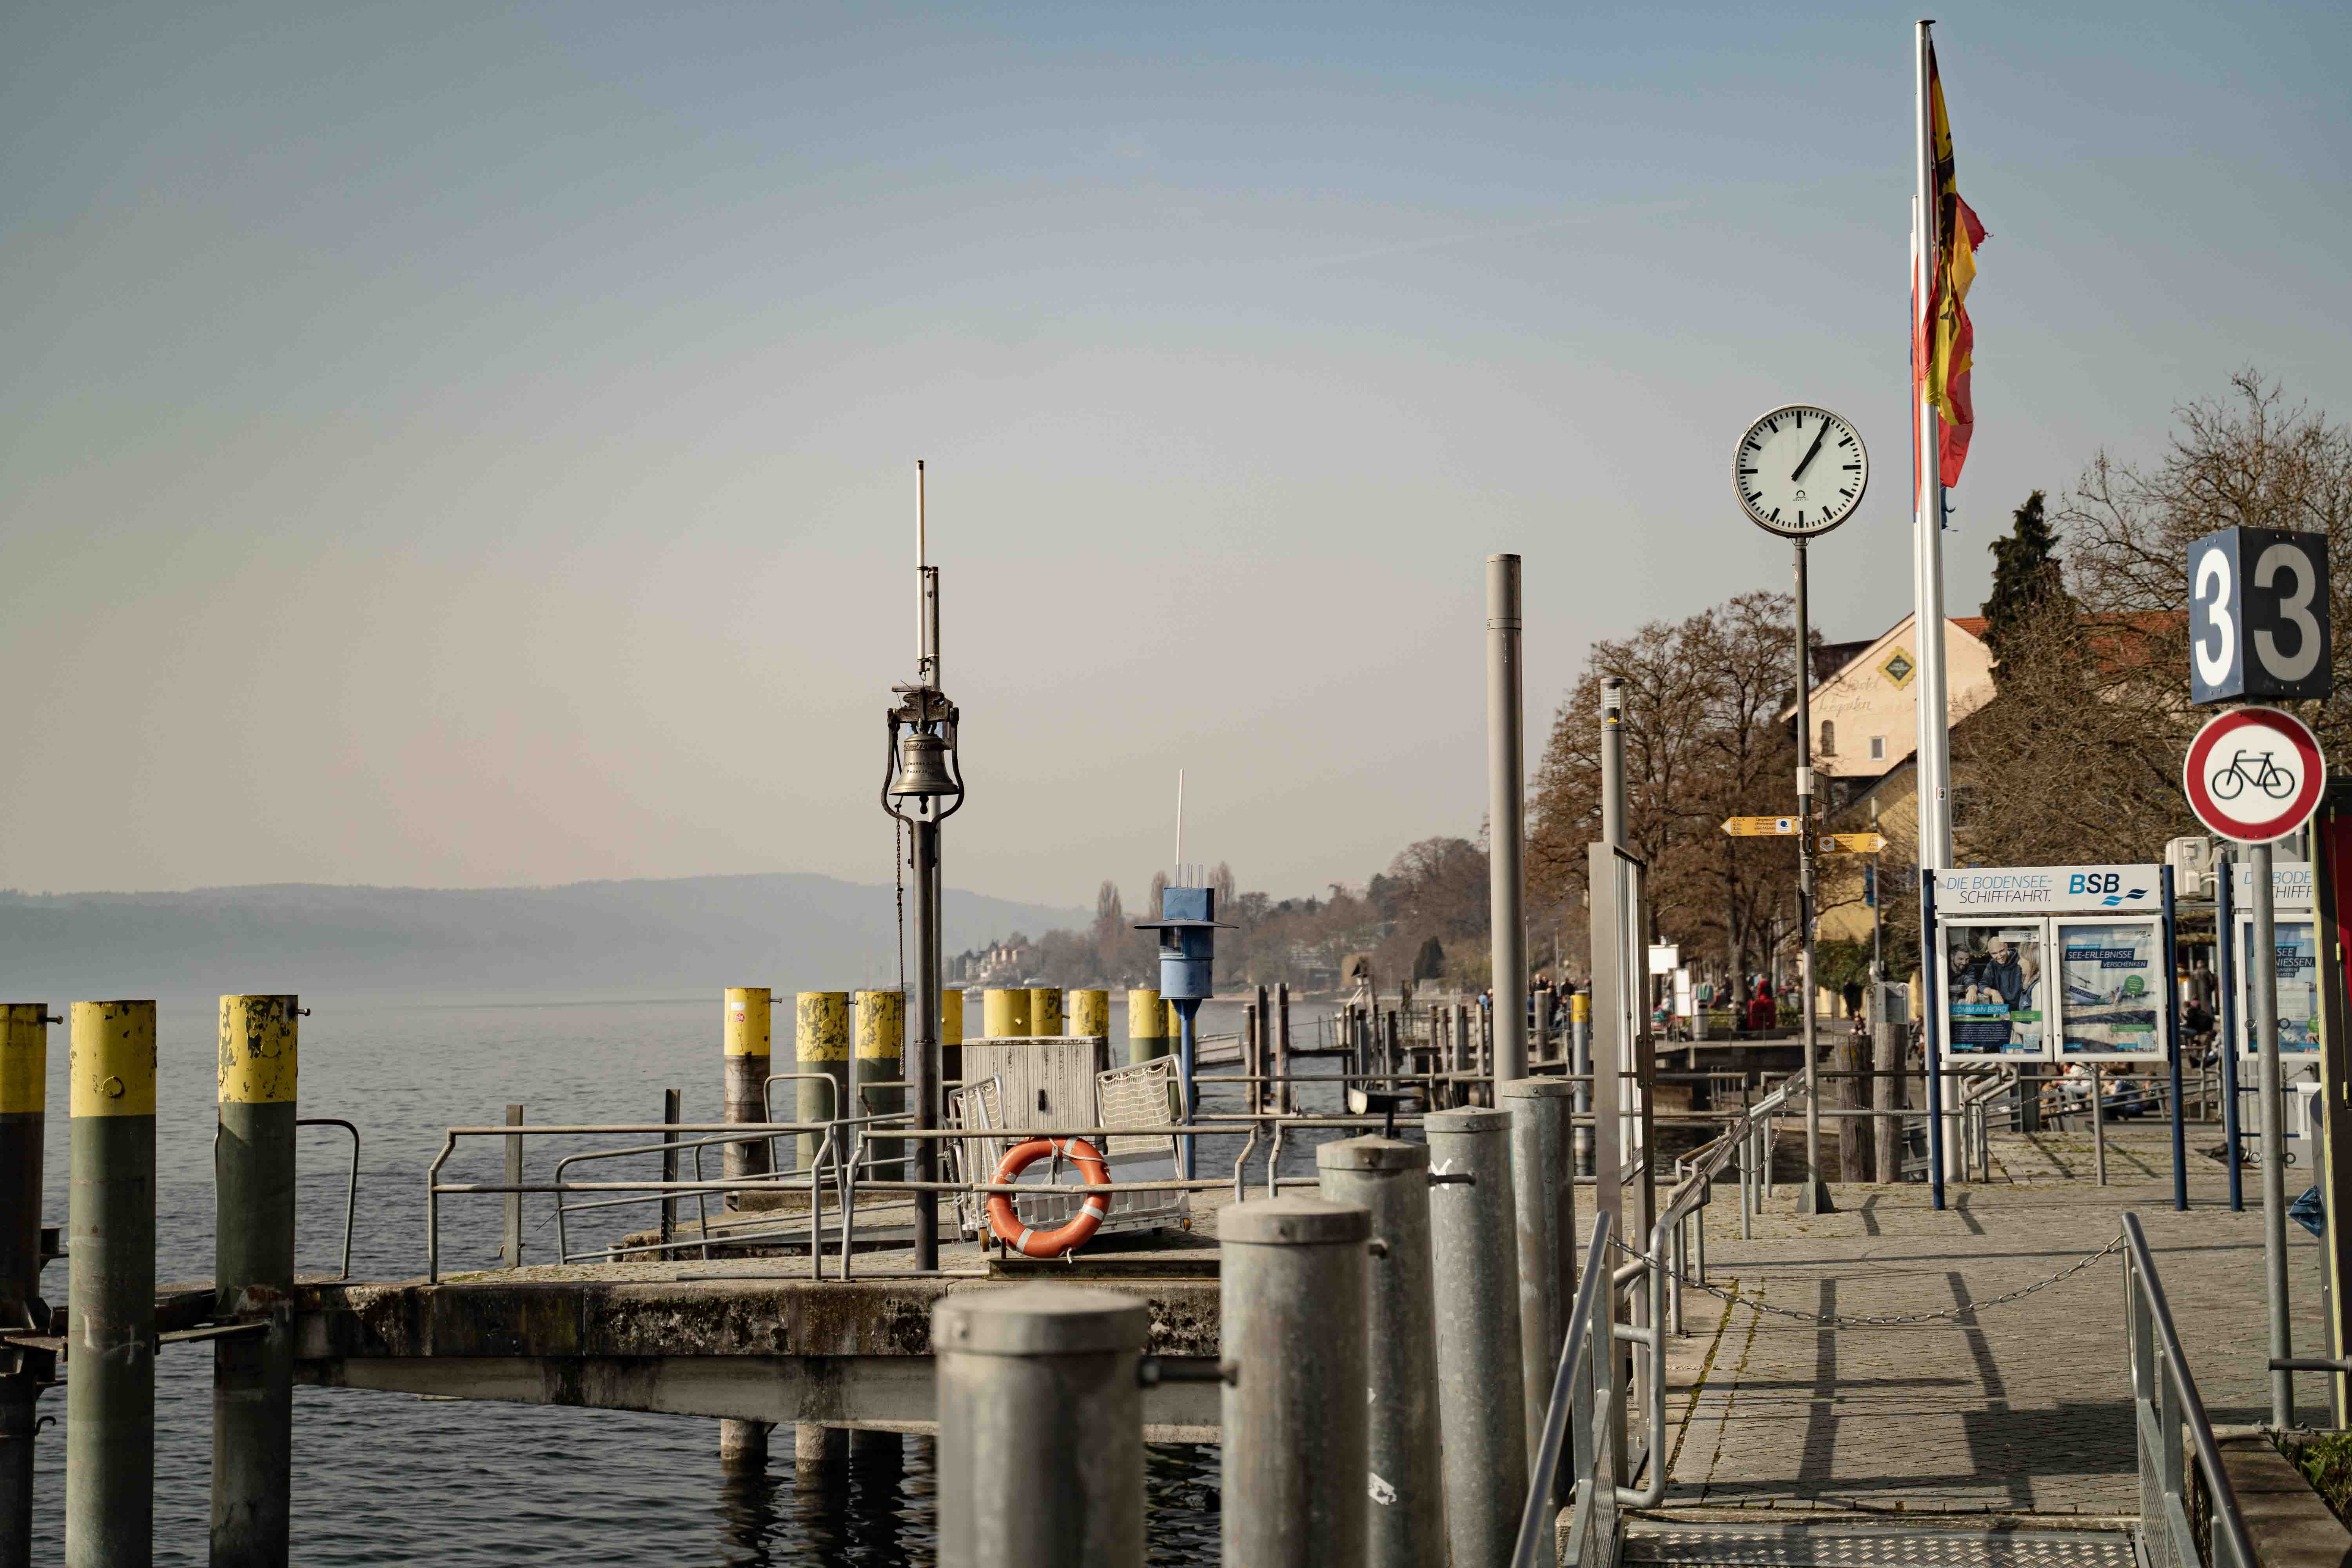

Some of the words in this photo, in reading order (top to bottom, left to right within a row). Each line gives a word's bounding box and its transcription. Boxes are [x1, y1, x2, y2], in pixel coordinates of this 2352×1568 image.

[2195, 549, 2234, 686] 3
[2254, 544, 2321, 681] 3
[1947, 877, 1969, 889] DIE
[1973, 875, 2053, 889] BODENSEE-
[2069, 873, 2120, 894] BSB
[1960, 889, 2051, 903] SCHIFFFAHRT.
[2068, 951, 2132, 959] SEE-ERLEBNISSE
